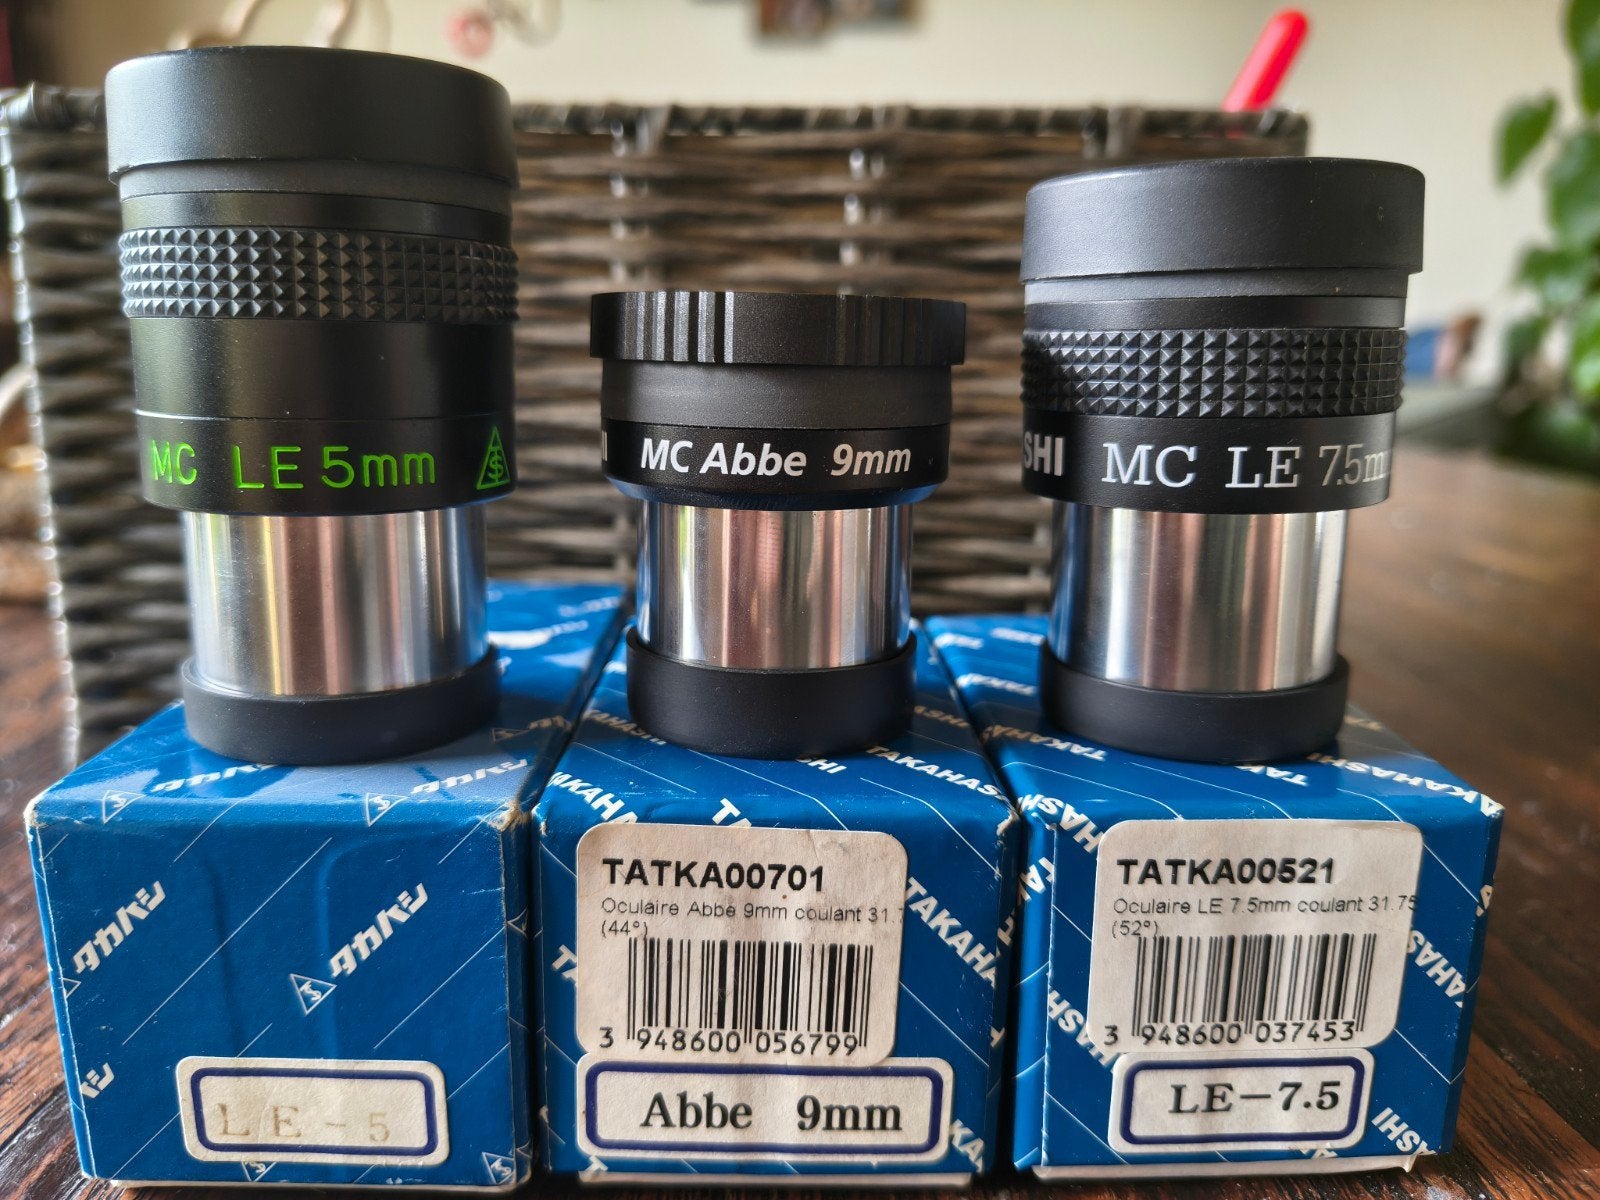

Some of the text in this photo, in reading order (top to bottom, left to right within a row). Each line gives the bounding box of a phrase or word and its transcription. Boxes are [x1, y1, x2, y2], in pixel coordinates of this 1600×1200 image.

[150, 439, 435, 489] MC LE 5mm
[640, 438, 693, 473] MC
[699, 442, 807, 476] Abbe
[831, 443, 911, 477] 9mm
[1101, 443, 1389, 488] MC LE 7.5m
[602, 857, 824, 892] TATKA00701
[1116, 856, 1334, 885] TATKA00521
[601, 897, 679, 916] Oculaire
[687, 901, 736, 917] Abbe
[743, 902, 788, 919] 9mm
[794, 905, 861, 921] coulant
[1113, 898, 1191, 914] Oculaire
[1198, 898, 1223, 914] LE
[1297, 896, 1363, 913] coulant
[72, 880, 166, 974] タカハシ
[330, 882, 429, 979] タカハシ
[599, 1026, 859, 1056] 3 948600 056799
[1103, 1020, 1355, 1046] 3 948600 037453
[639, 1090, 903, 1133] Abbe 9mm
[1168, 1080, 1341, 1114] LE-7.5
